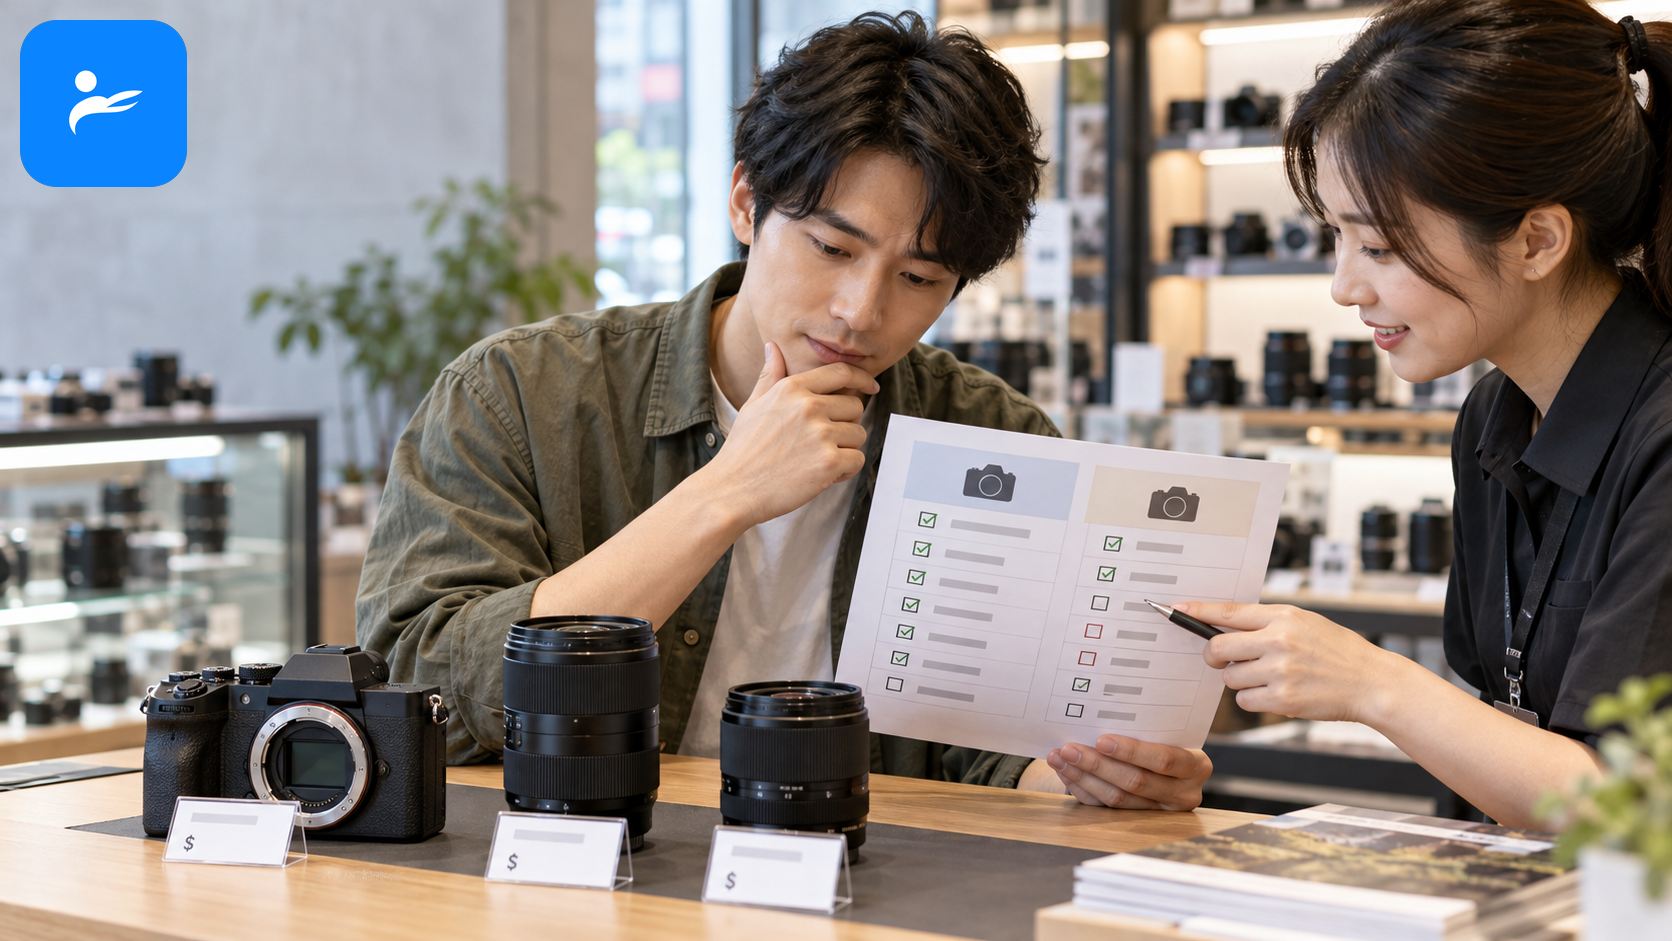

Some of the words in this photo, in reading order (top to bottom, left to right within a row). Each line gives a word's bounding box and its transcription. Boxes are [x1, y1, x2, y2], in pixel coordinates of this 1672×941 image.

[184, 835, 195, 852] $
[507, 853, 518, 871] $
[725, 871, 736, 890] $
